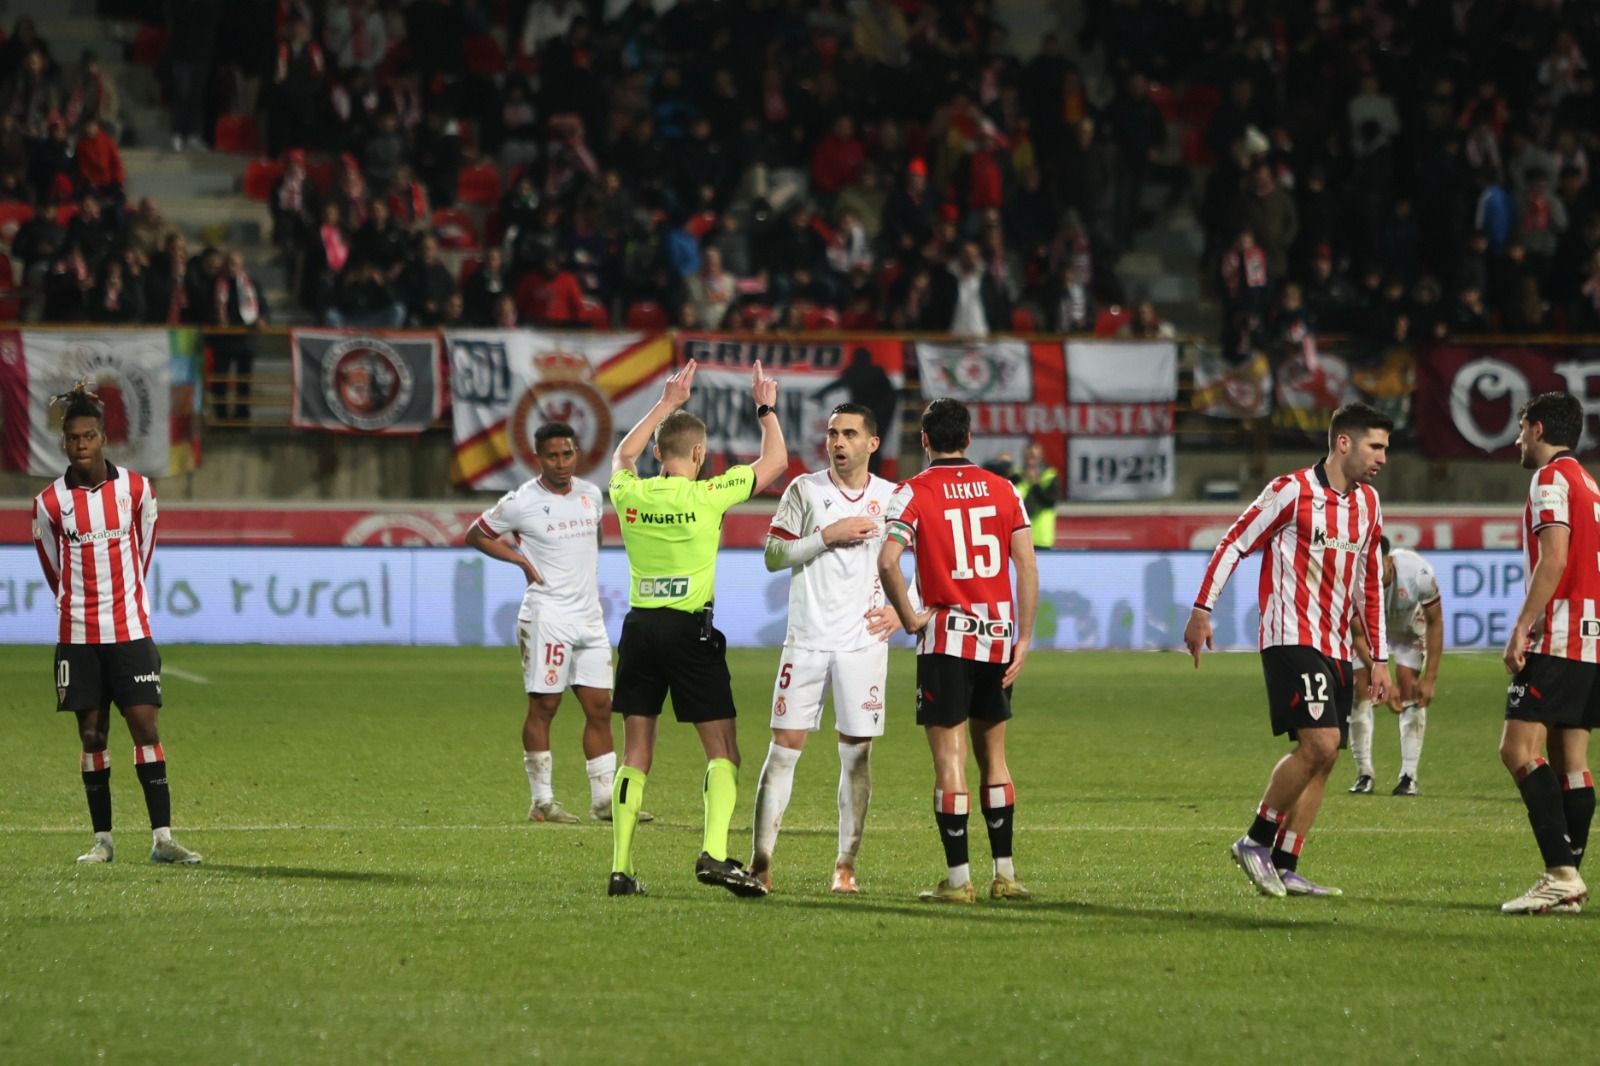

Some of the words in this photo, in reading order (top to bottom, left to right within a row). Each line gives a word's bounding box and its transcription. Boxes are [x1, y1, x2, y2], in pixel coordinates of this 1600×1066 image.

[968, 406, 1169, 434] LTURALISTAS
[1079, 454, 1166, 485] 1923
[944, 505, 1001, 579] 15
[231, 561, 391, 626] rural
[639, 580, 688, 595] BKT
[947, 615, 1012, 637] DIGI
[1453, 612, 1508, 647] DE
[545, 642, 565, 667] 15
[779, 663, 793, 690] 5
[1301, 672, 1329, 701] 12
